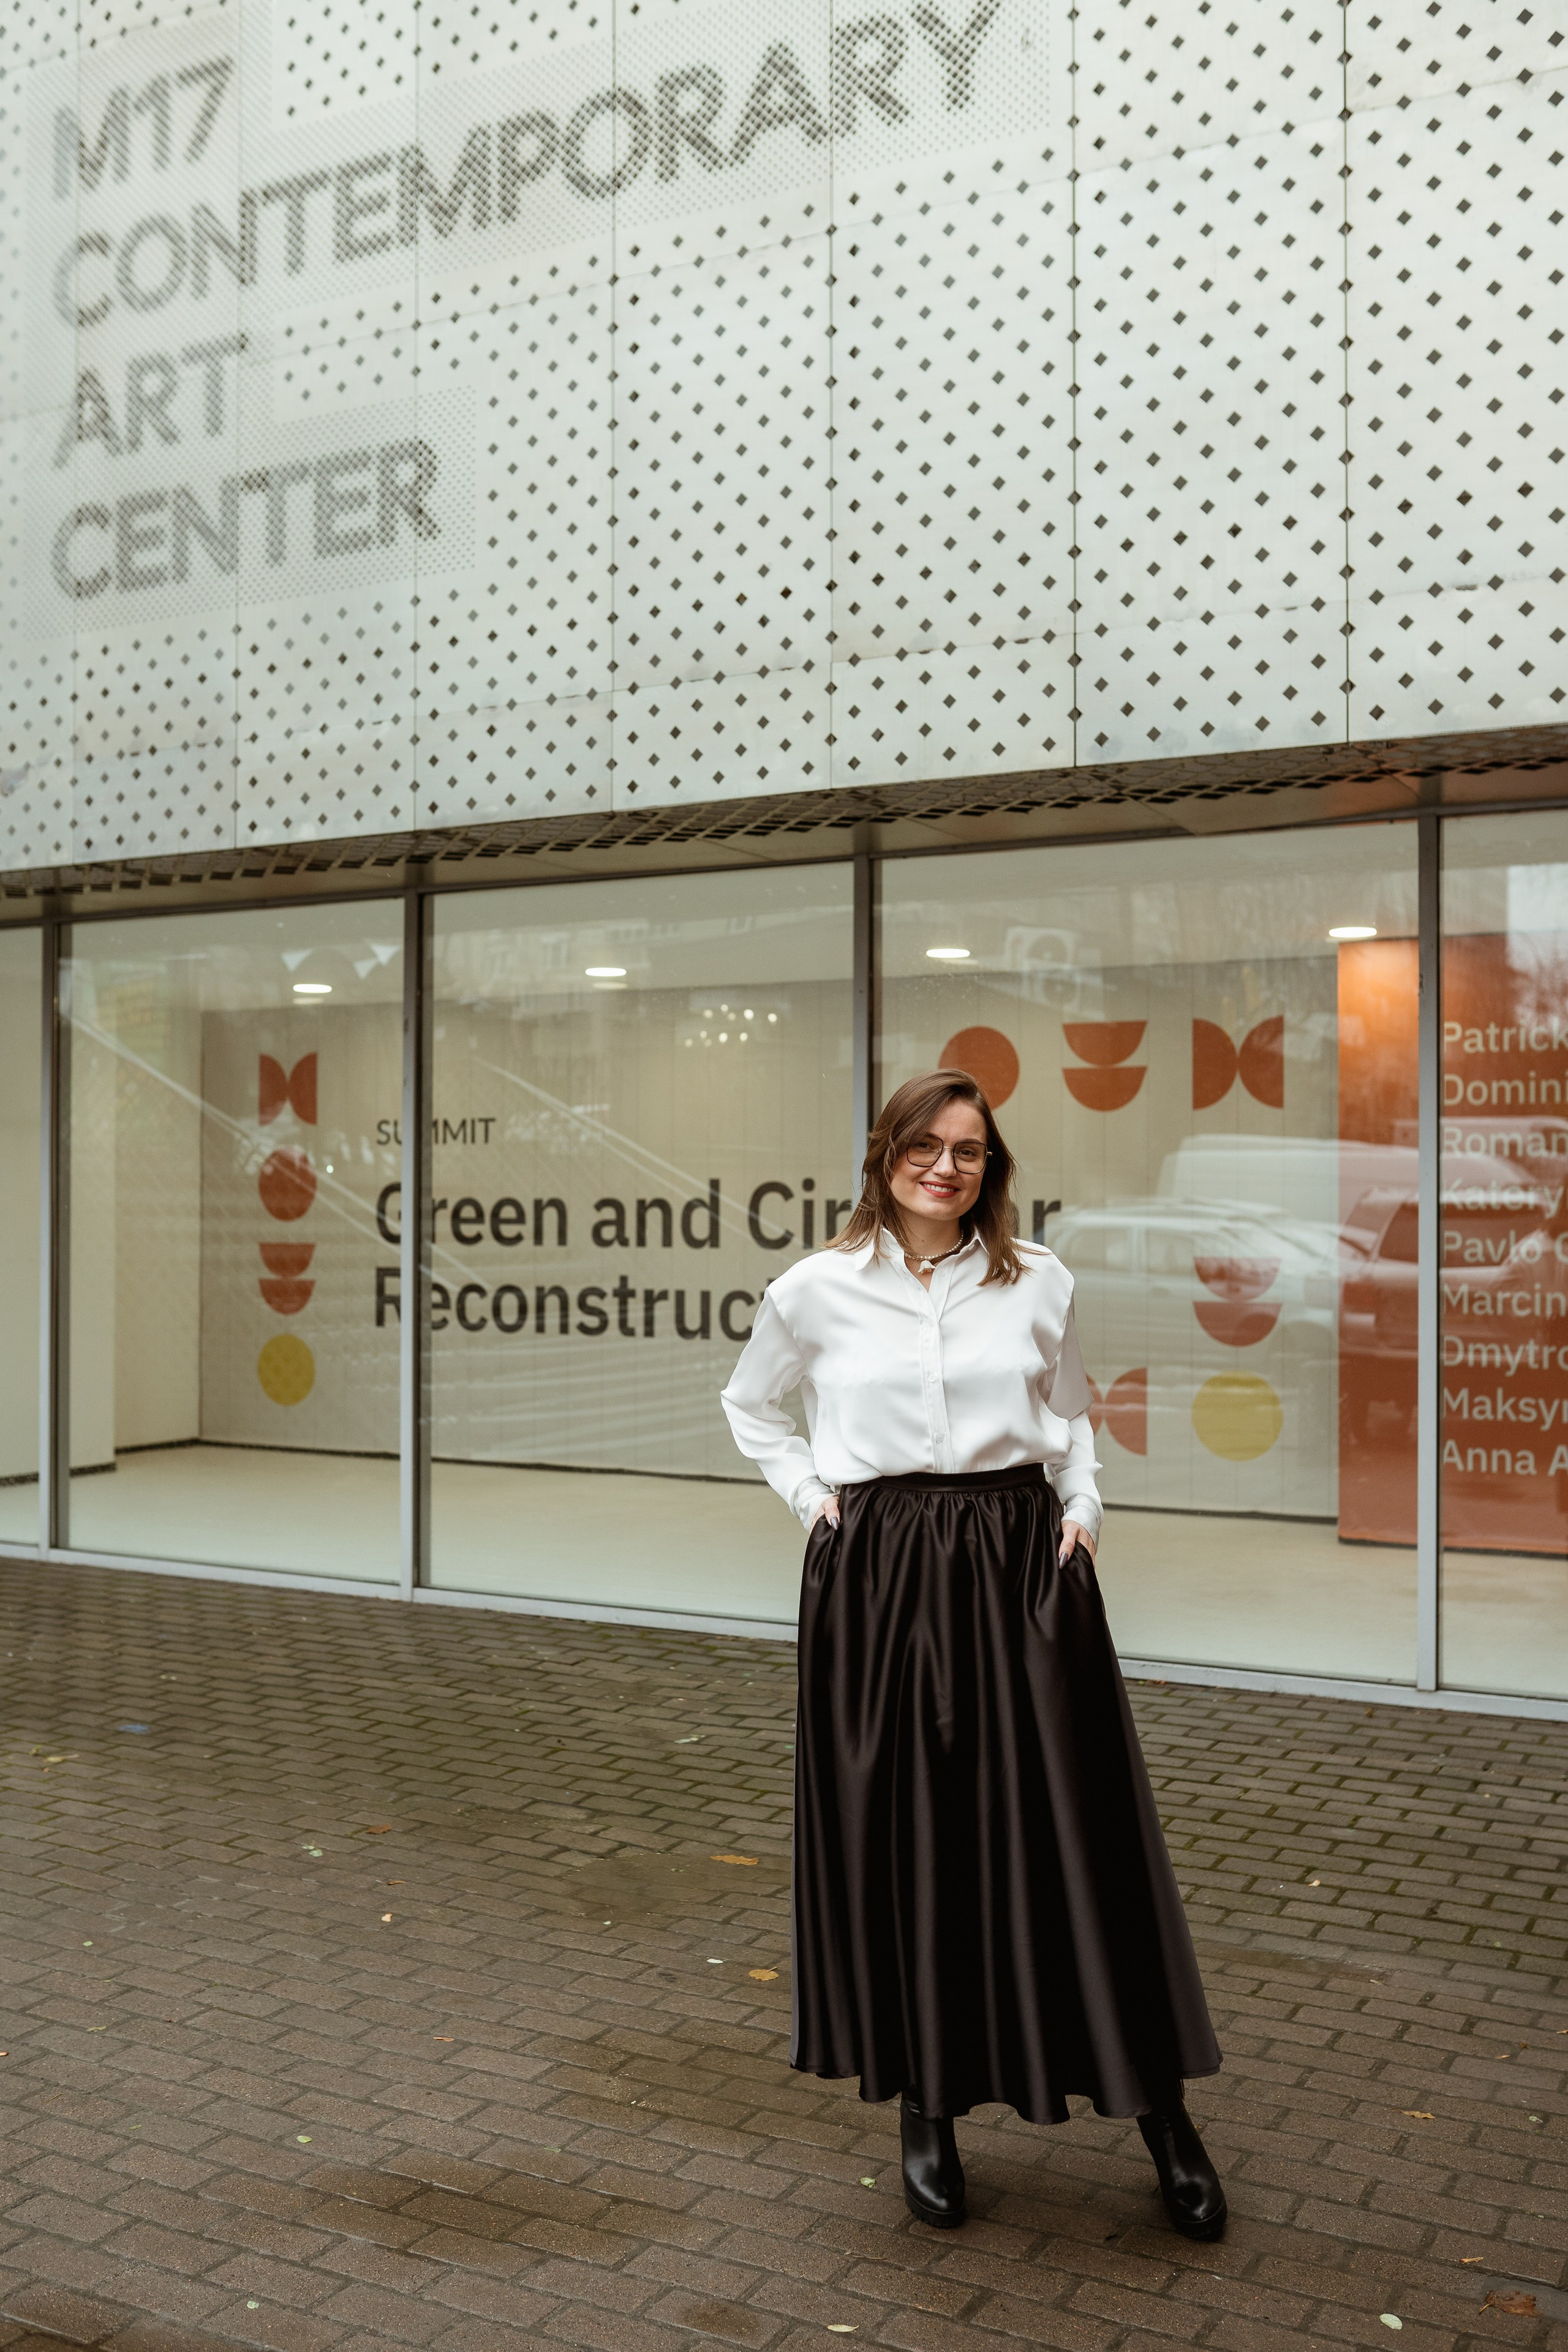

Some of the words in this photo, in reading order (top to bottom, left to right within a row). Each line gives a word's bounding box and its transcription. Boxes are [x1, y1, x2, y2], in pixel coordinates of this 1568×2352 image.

[52, 0, 1001, 330] CONTEMPORARY
[53, 55, 235, 202] M17
[51, 331, 249, 472] ART
[52, 437, 441, 600] CENTER
[375, 1182, 568, 1248] Green
[591, 1178, 720, 1249] and
[748, 1177, 1061, 1251] Cirr
[1444, 1177, 1568, 1219] Katery
[1444, 1228, 1543, 1264] Pavlo
[375, 1267, 776, 1341] Reconstruc
[1444, 1283, 1567, 1319] Marcin
[1444, 1387, 1568, 1431] Maksy
[1444, 1439, 1537, 1476] Anna
